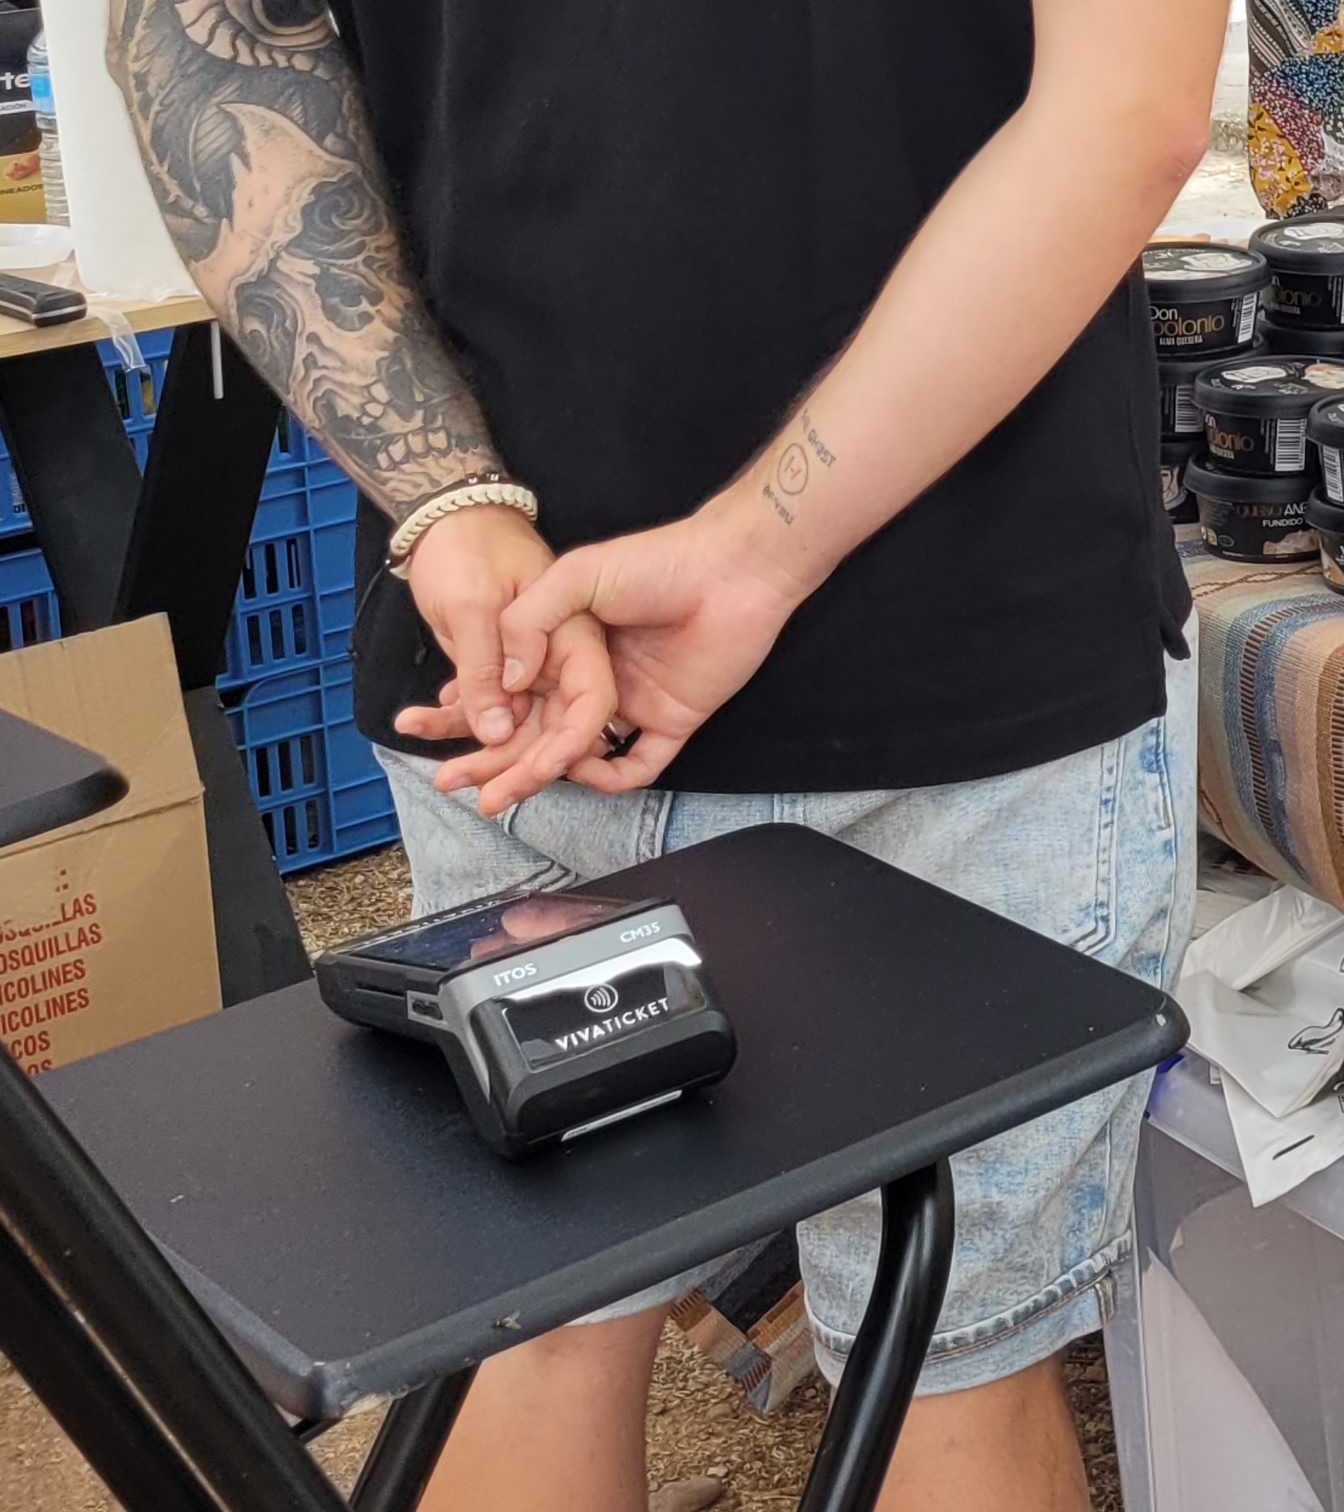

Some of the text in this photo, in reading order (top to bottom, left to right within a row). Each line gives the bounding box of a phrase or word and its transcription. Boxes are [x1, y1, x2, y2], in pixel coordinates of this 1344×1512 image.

[1152, 314, 1225, 337] polonio
[619, 921, 662, 944] CM35
[493, 962, 538, 987] ITOS
[554, 996, 670, 1052] VIVATICKET
